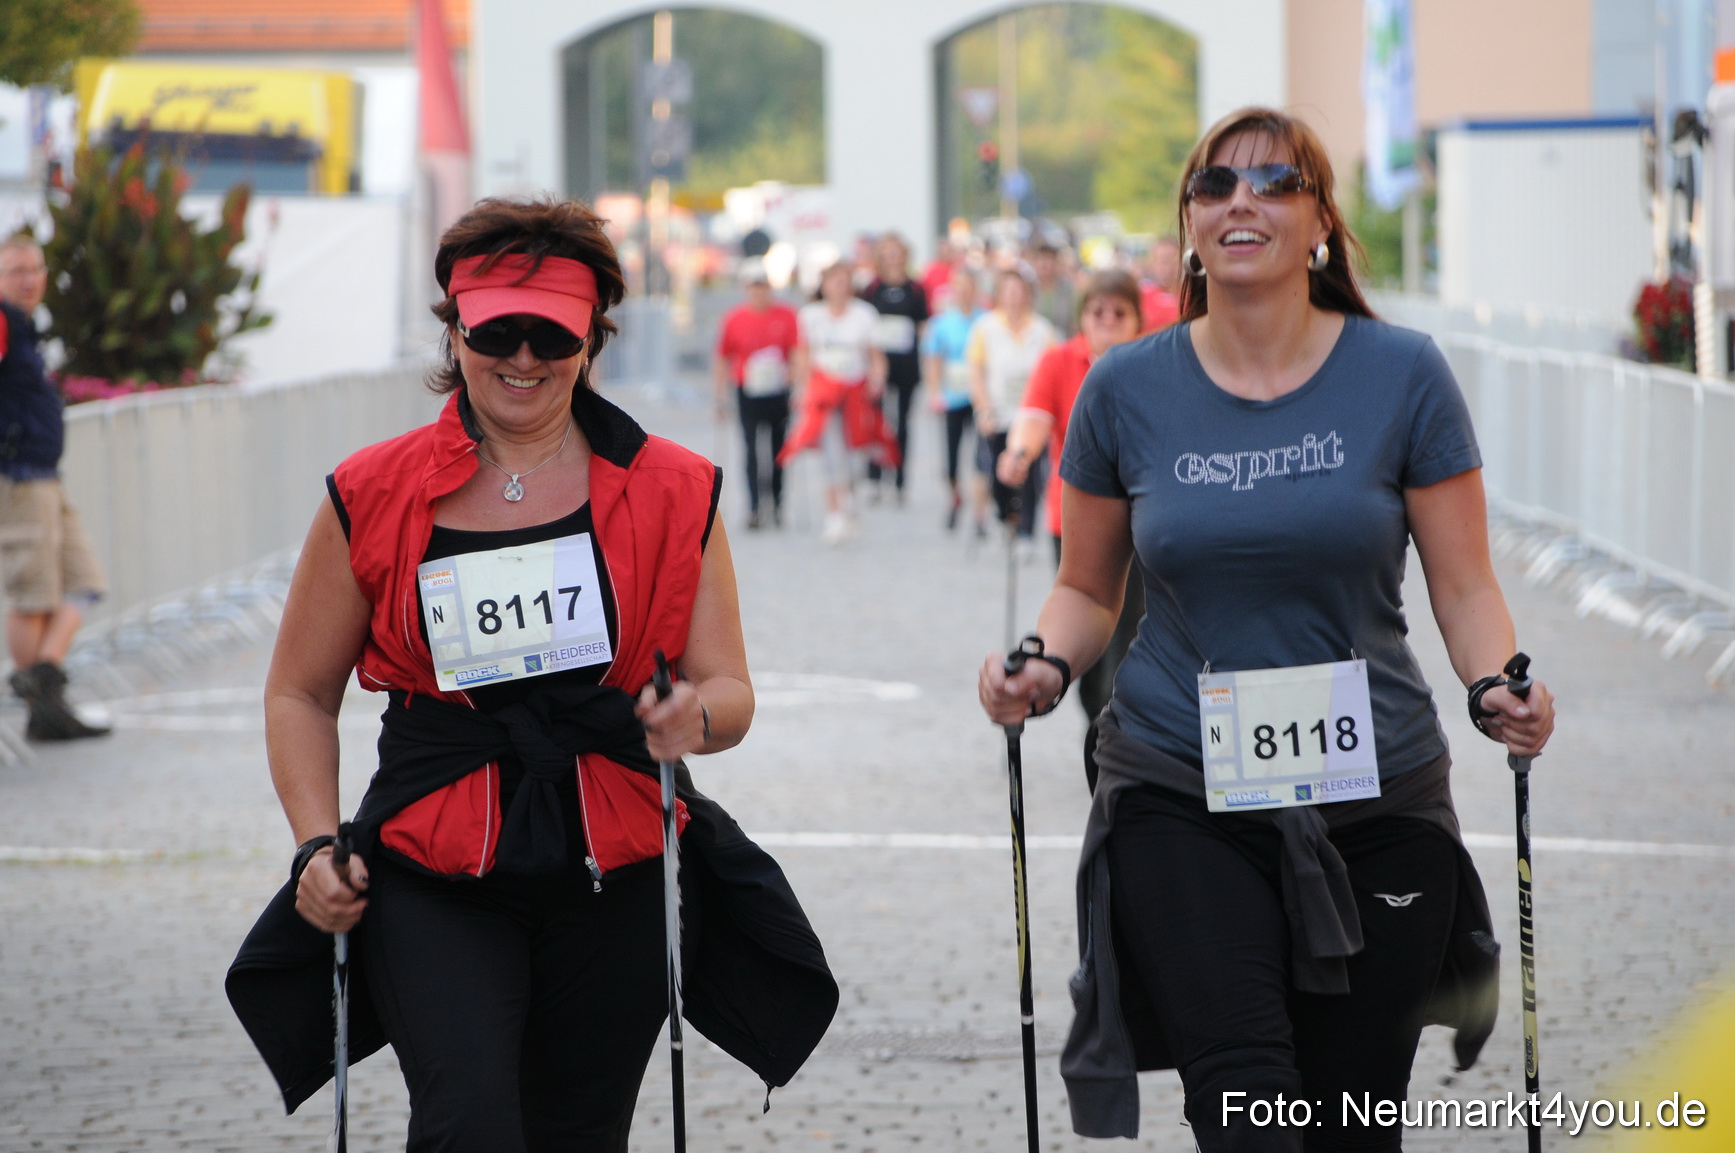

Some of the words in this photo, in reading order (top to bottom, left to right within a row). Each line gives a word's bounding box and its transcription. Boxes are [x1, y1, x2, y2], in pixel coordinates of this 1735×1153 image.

[1175, 430, 1344, 491] esprit
[432, 605, 444, 624] N
[476, 585, 582, 635] 8117
[543, 642, 607, 663] PFLEIDERER
[456, 664, 500, 682] BOCK
[1211, 726, 1221, 744] N
[1254, 716, 1359, 760] 8118
[1314, 776, 1376, 793] PFLEIDERER
